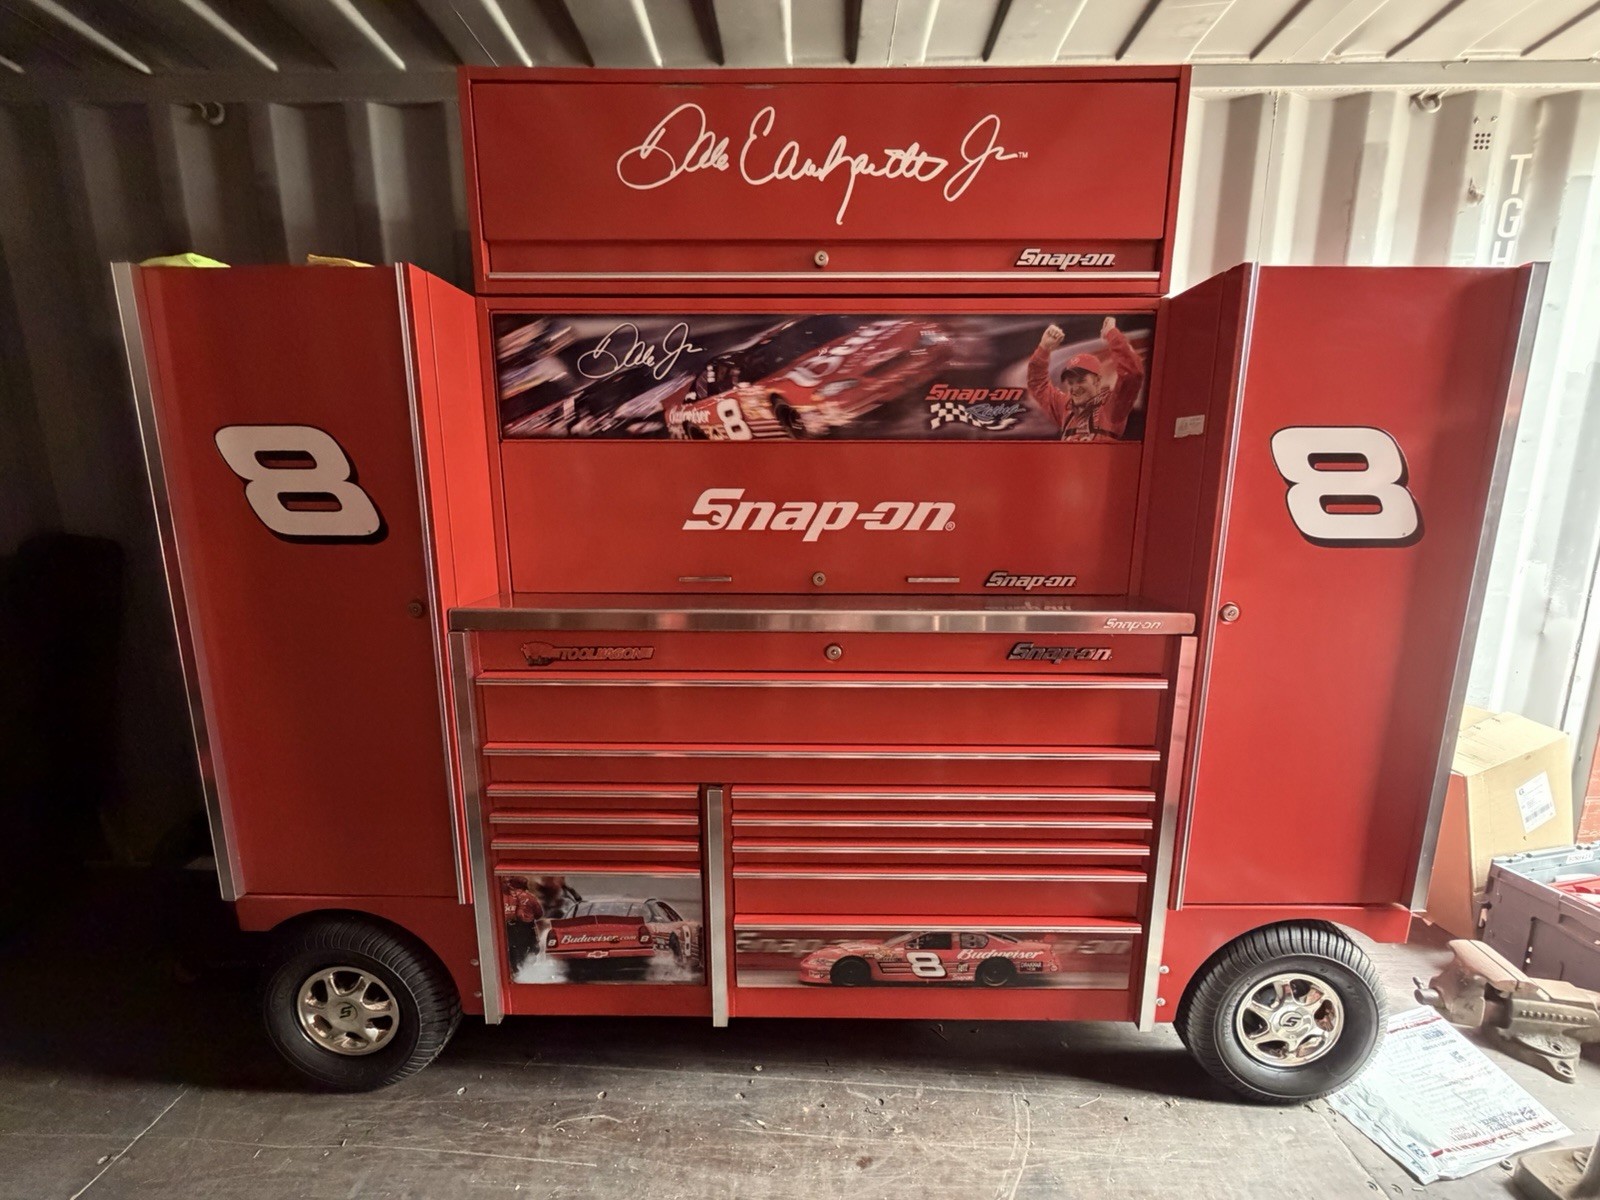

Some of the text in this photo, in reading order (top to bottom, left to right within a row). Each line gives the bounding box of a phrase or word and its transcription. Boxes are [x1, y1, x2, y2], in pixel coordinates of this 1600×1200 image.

[1016, 248, 1116, 270] Snap-on
[925, 384, 1024, 404] Snap-on
[716, 398, 753, 440] 8
[214, 424, 388, 544] 8
[1270, 426, 1424, 547] 8
[985, 571, 1077, 590] Snap-on
[1103, 618, 1162, 632] Snap-on
[1008, 643, 1113, 664] Snap-on
[906, 951, 947, 978] 8
[957, 949, 1044, 960] Budweiser
